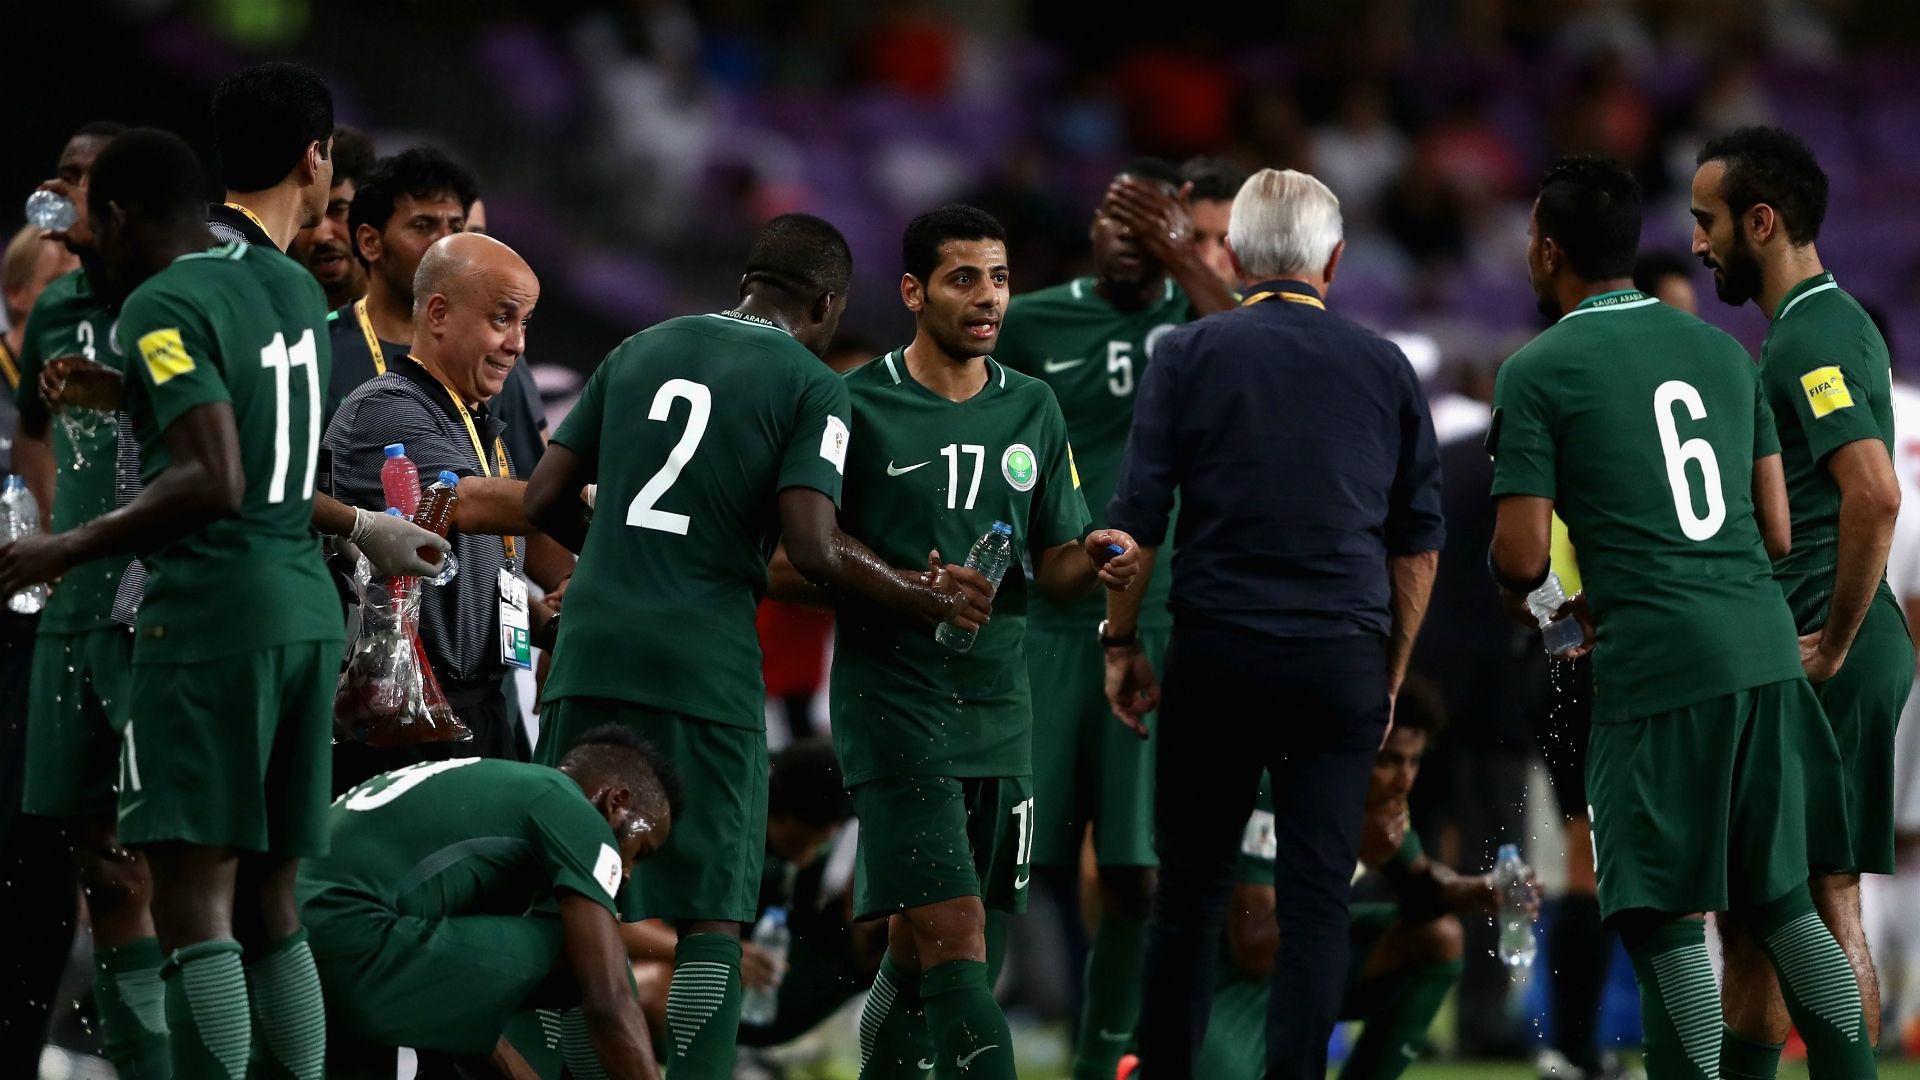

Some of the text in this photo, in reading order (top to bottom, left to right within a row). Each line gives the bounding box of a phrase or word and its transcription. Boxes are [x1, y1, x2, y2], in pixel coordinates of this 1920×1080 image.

[721, 309, 773, 325] SAUDI ARABIA
[1593, 297, 1618, 306] SAUDI
[1106, 341, 1134, 397] 5
[1809, 381, 1832, 398] FIFA
[260, 328, 322, 504] 11
[626, 379, 712, 536] 2
[940, 443, 985, 510] 17
[1653, 380, 1727, 541] 6
